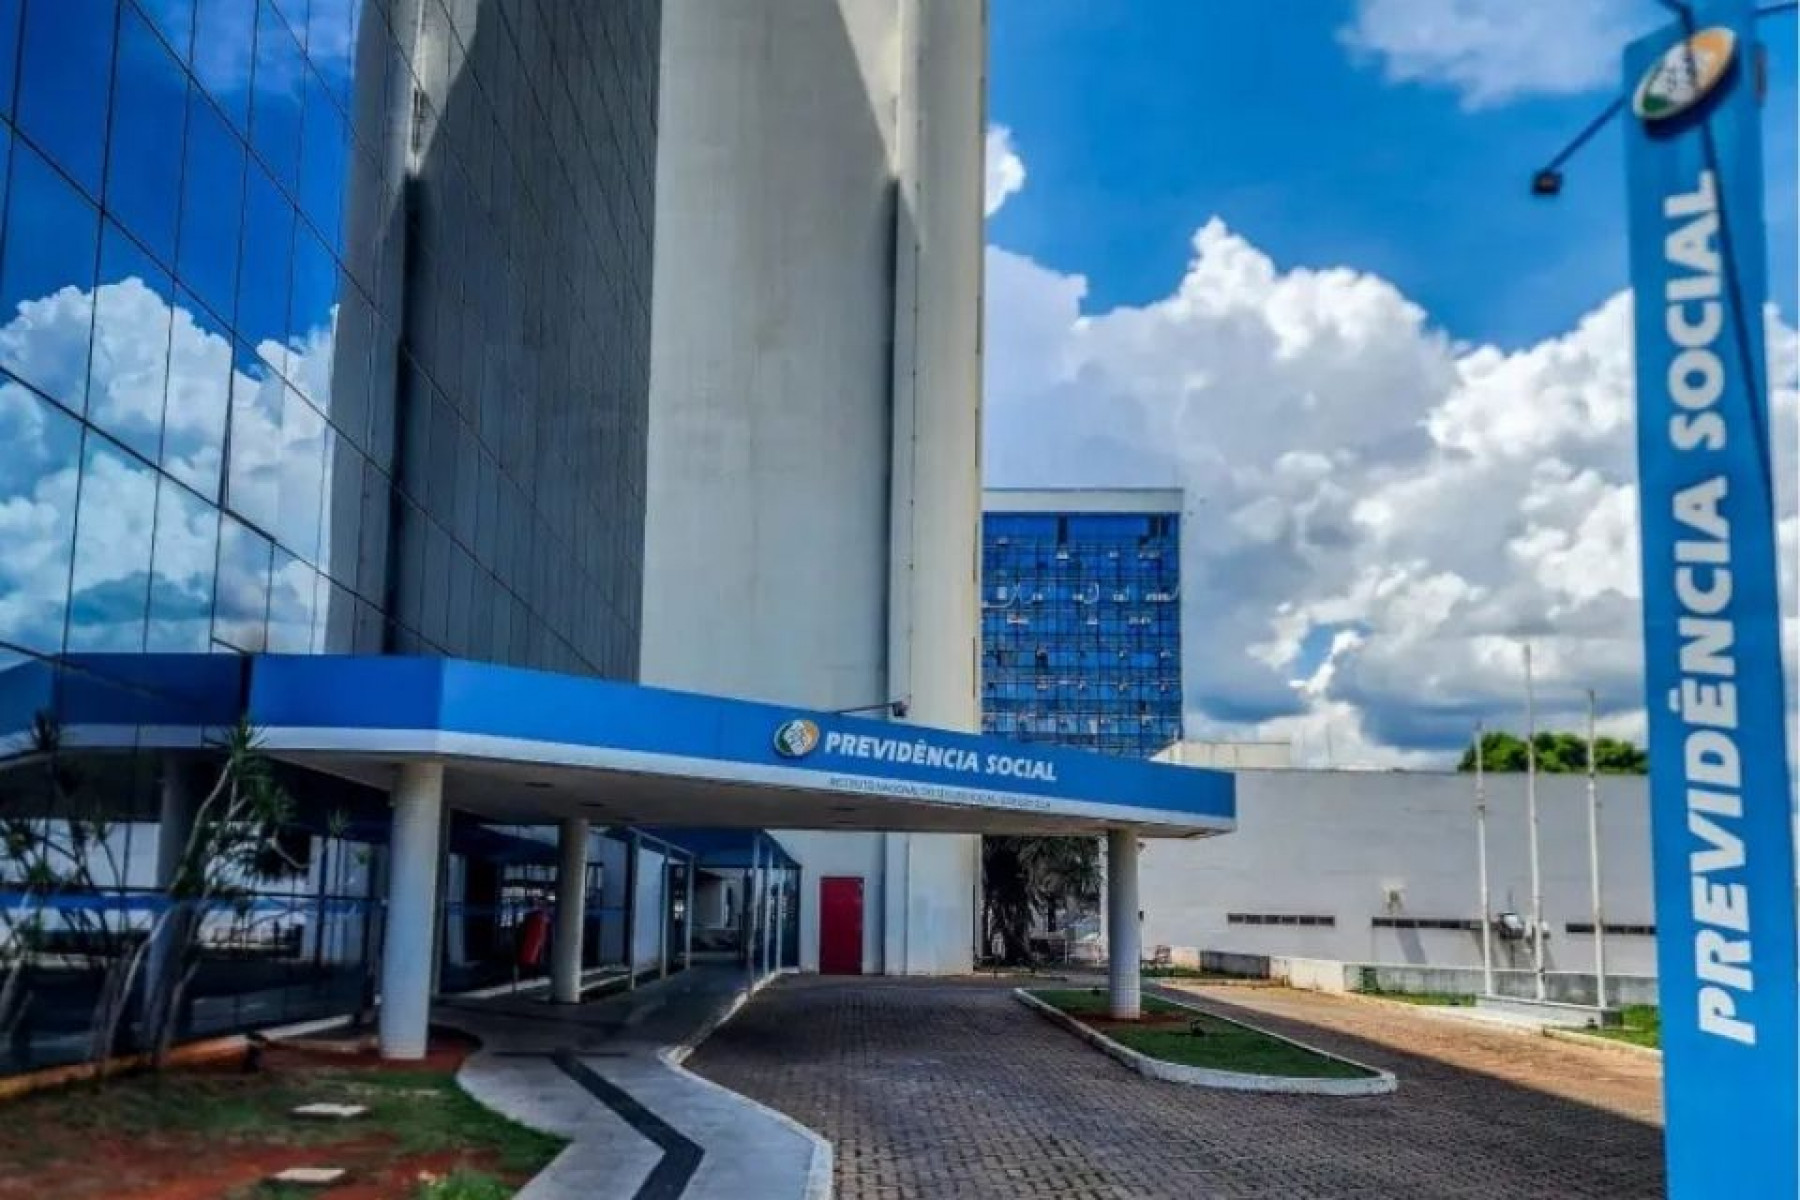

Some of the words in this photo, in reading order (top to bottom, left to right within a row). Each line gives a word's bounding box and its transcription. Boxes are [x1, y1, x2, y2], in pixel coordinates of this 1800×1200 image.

[1664, 170, 1727, 451] SOCIAL
[825, 731, 979, 773] PREVIDÊNCIA
[985, 754, 1057, 781] SOCIAL
[1669, 475, 1756, 1045] PREVIDÊNCIA
